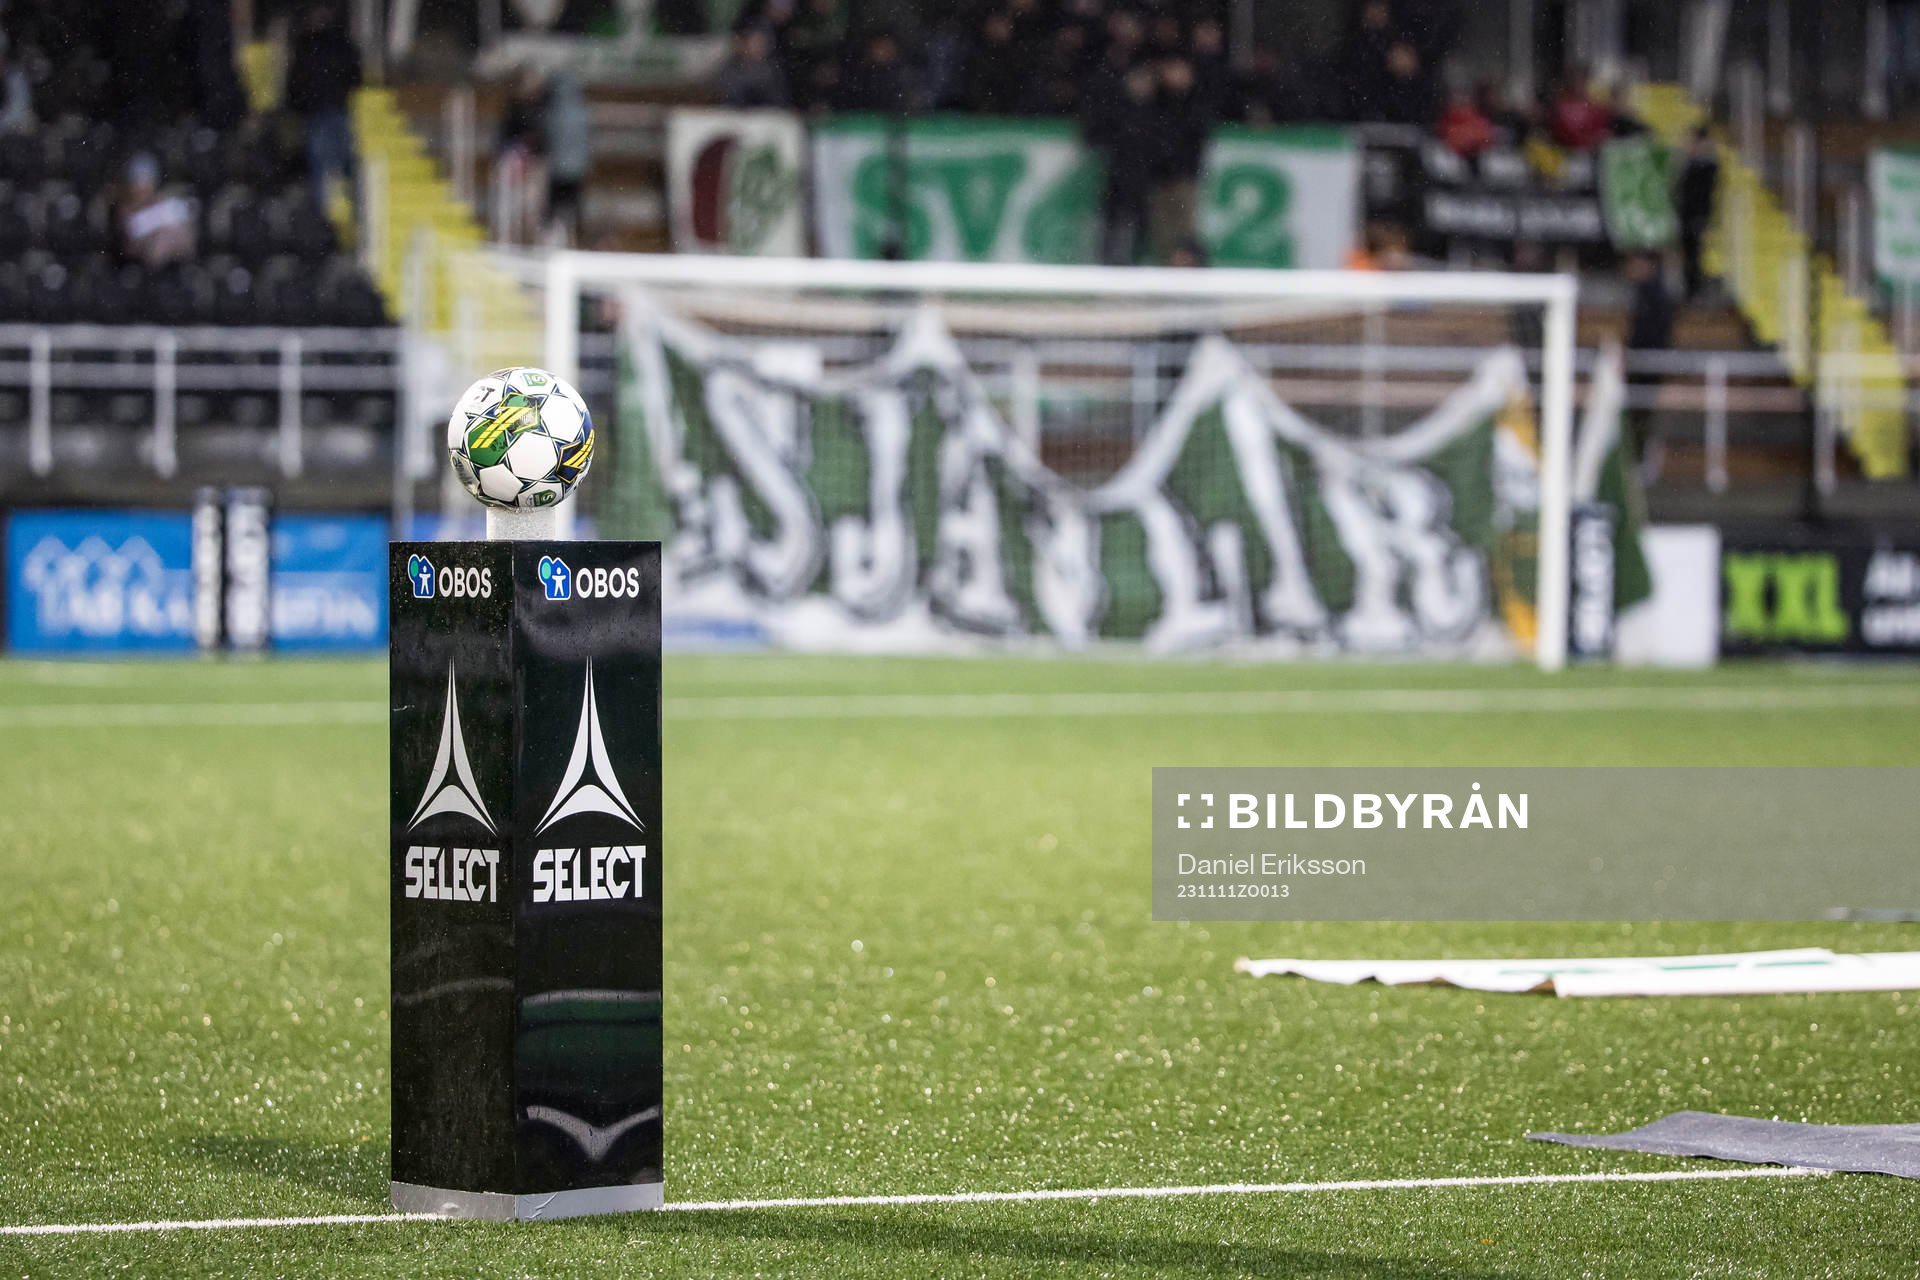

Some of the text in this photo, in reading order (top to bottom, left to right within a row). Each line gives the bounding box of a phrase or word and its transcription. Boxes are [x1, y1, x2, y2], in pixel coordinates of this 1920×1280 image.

[1213, 163, 1293, 268] 2
[438, 567, 492, 598] OBOS
[576, 567, 640, 598] OBOS
[1725, 551, 1847, 645] XXL
[405, 846, 500, 903] SELECT
[533, 845, 647, 903] SELECT
